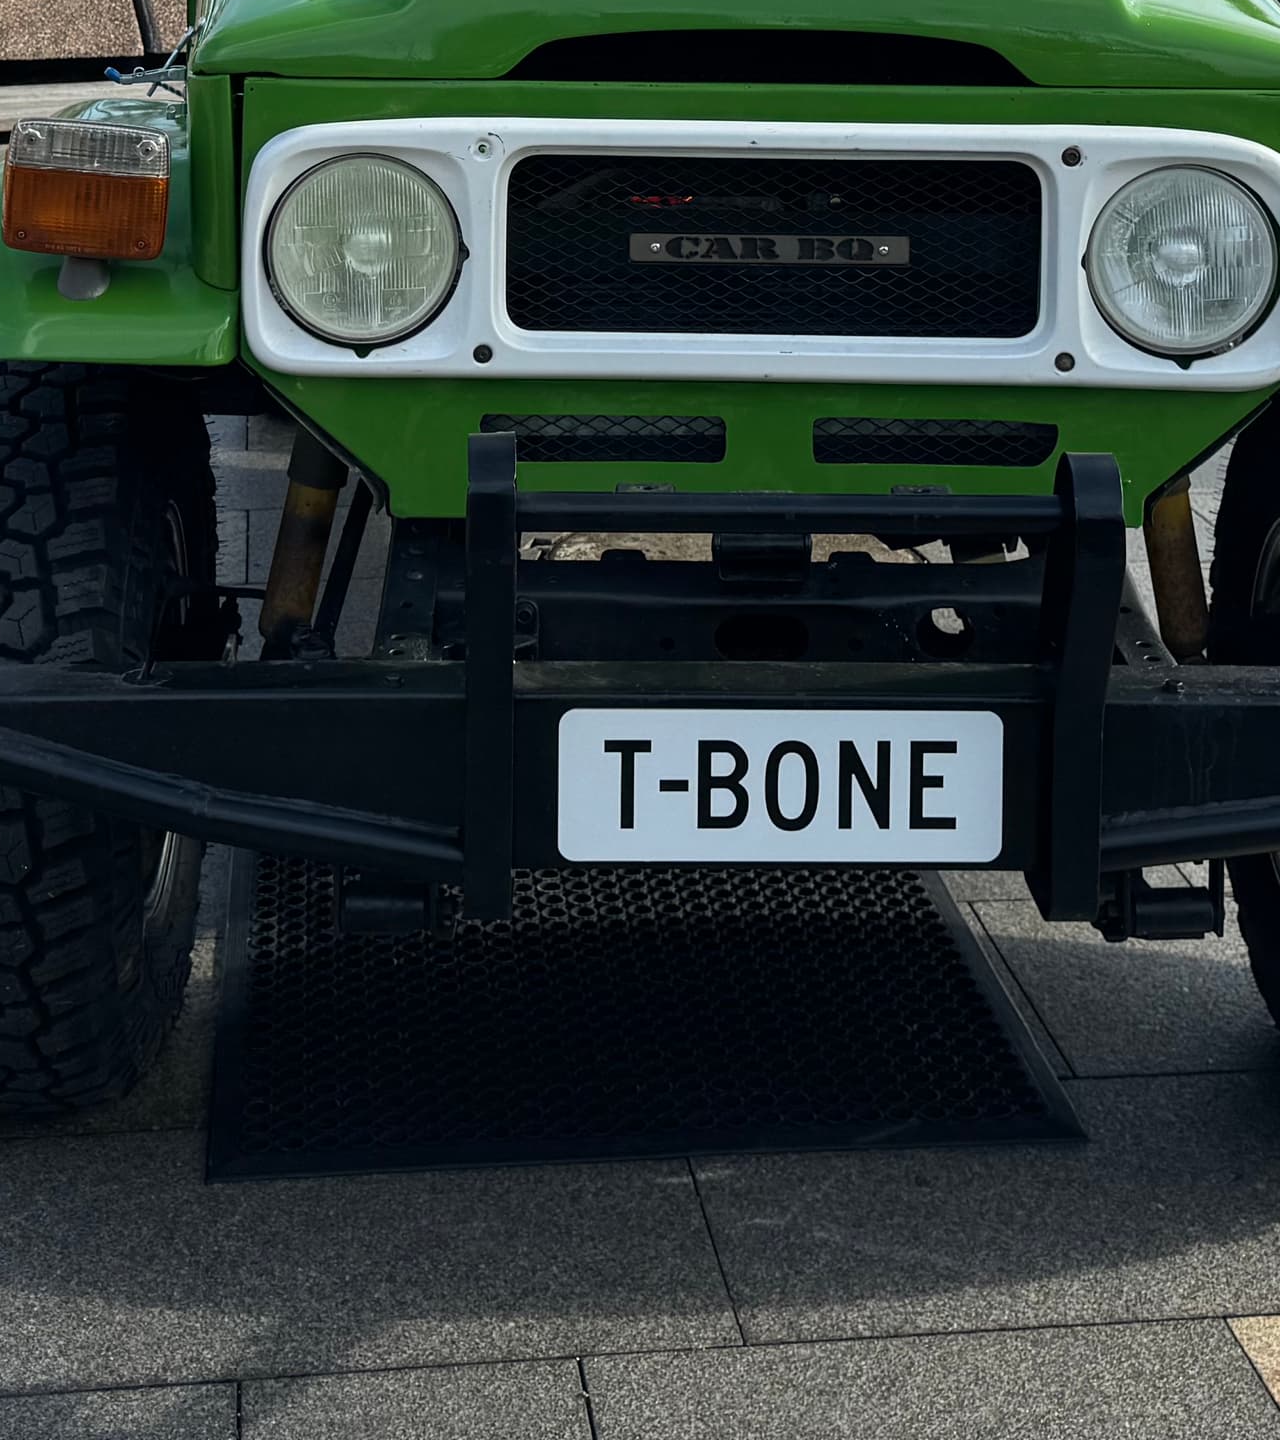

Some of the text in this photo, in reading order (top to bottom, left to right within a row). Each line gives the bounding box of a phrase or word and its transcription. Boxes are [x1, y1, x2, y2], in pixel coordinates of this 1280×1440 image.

[665, 236, 875, 261] CAR BQ
[604, 739, 958, 832] T-BONE
